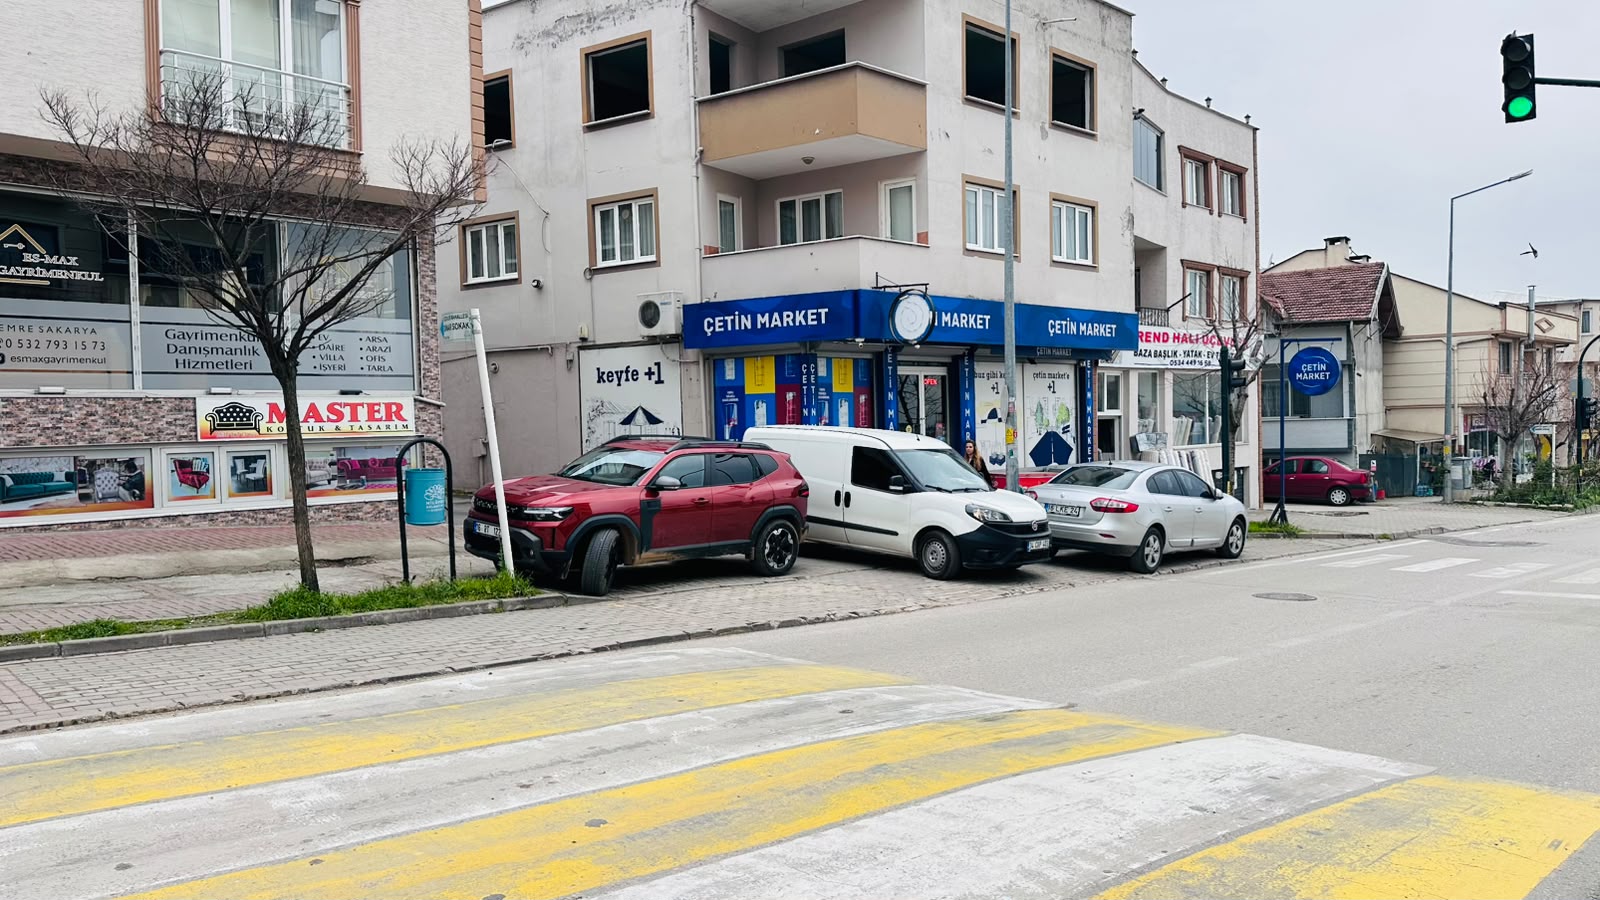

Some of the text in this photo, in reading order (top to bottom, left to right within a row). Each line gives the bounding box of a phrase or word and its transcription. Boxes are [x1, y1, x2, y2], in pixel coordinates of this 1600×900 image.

[22, 252, 79, 266] ES-MAX
[0, 265, 104, 281] GAYRİMENKUL
[704, 308, 829, 336] ÇETİN MARKET
[941, 311, 991, 329] MARKET
[38, 325, 98, 335] SAKARYA
[1047, 317, 1117, 337] ÇETİN MARKET
[365, 336, 389, 344] ARSA
[1137, 331, 1170, 344] REND
[17, 338, 41, 349] 532
[45, 340, 68, 350] 793
[74, 341, 87, 350] 15
[91, 341, 106, 351] 73
[166, 343, 260, 357] Danışmanlık
[318, 344, 345, 352] DAİRE
[365, 345, 391, 353] ARAZİ
[10, 354, 107, 365] esmaxgayrimenkul
[319, 353, 345, 361] VİLLA
[1153, 350, 1178, 360] BAŞLIK
[1183, 350, 1202, 358] YATAK
[175, 358, 253, 370] Hizmetleri
[319, 363, 346, 372] İŞYERİ
[1301, 362, 1326, 373] ÇETİN
[596, 361, 665, 387] keyfe +1
[1032, 371, 1046, 381] çetin
[1296, 372, 1331, 380] MARKET
[991, 382, 1000, 394] +1
[1047, 380, 1056, 394] +1
[265, 401, 409, 424] MASTER
[266, 424, 326, 432] KOUK
